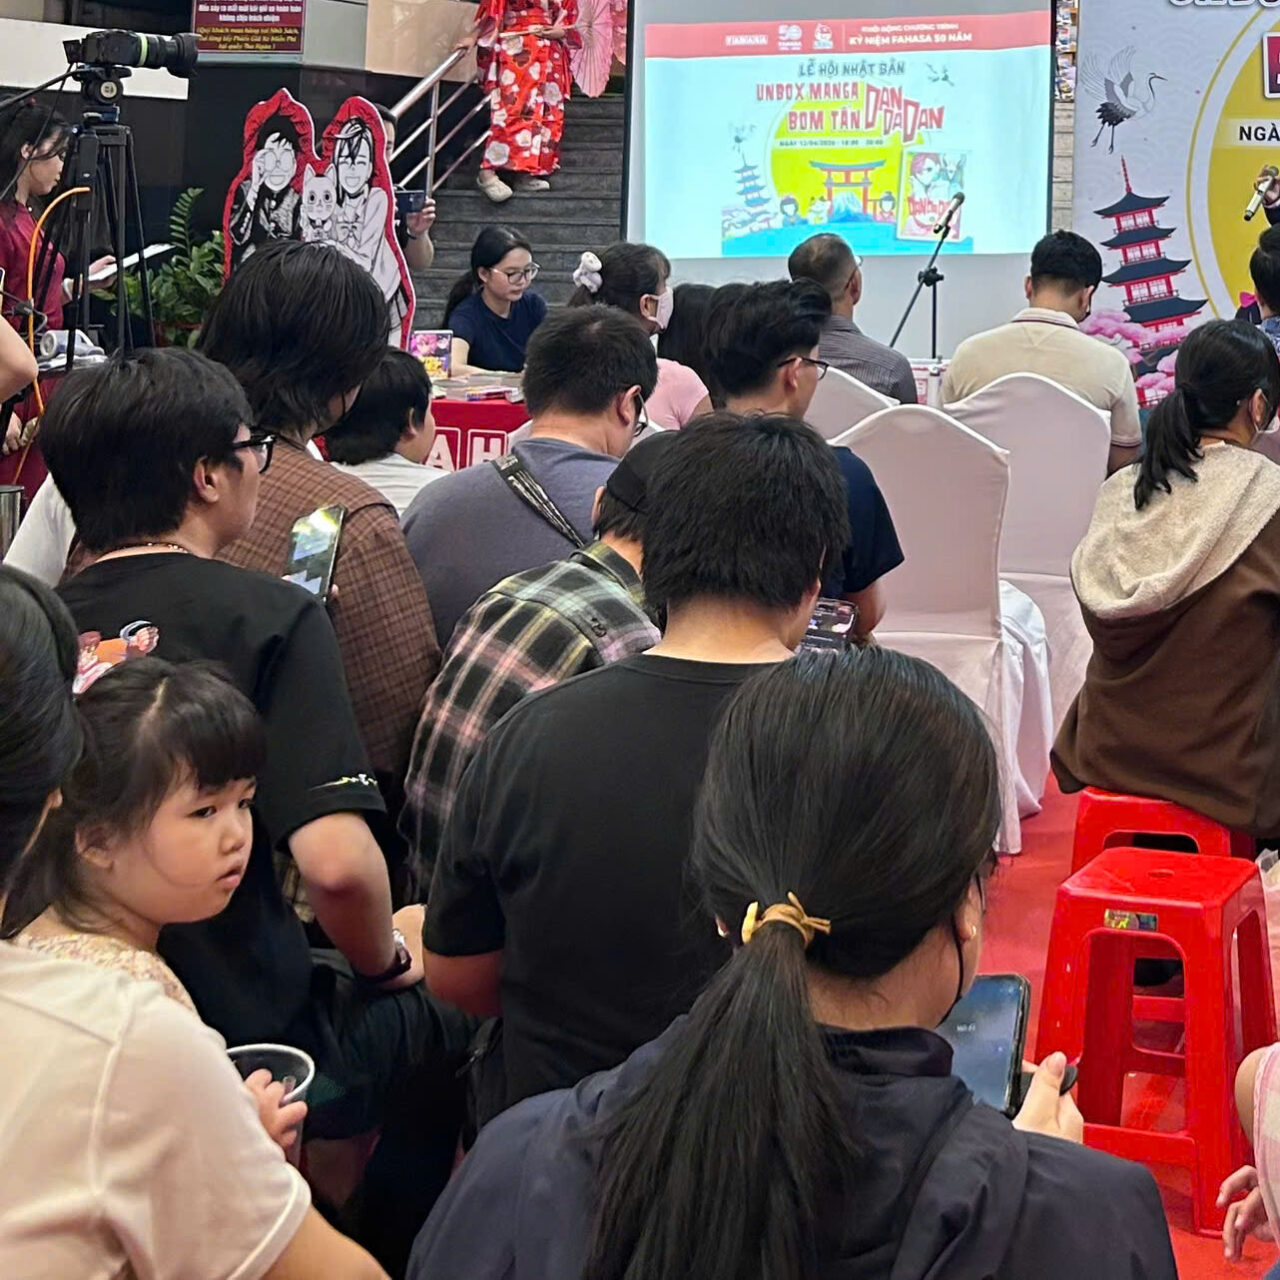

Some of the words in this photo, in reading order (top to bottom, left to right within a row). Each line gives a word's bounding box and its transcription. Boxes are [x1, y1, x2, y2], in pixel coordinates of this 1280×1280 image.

[892, 34, 932, 44] FAHASA
[757, 83, 804, 101] UNBOX
[809, 82, 859, 100] MANGA
[788, 110, 824, 131] BOM
